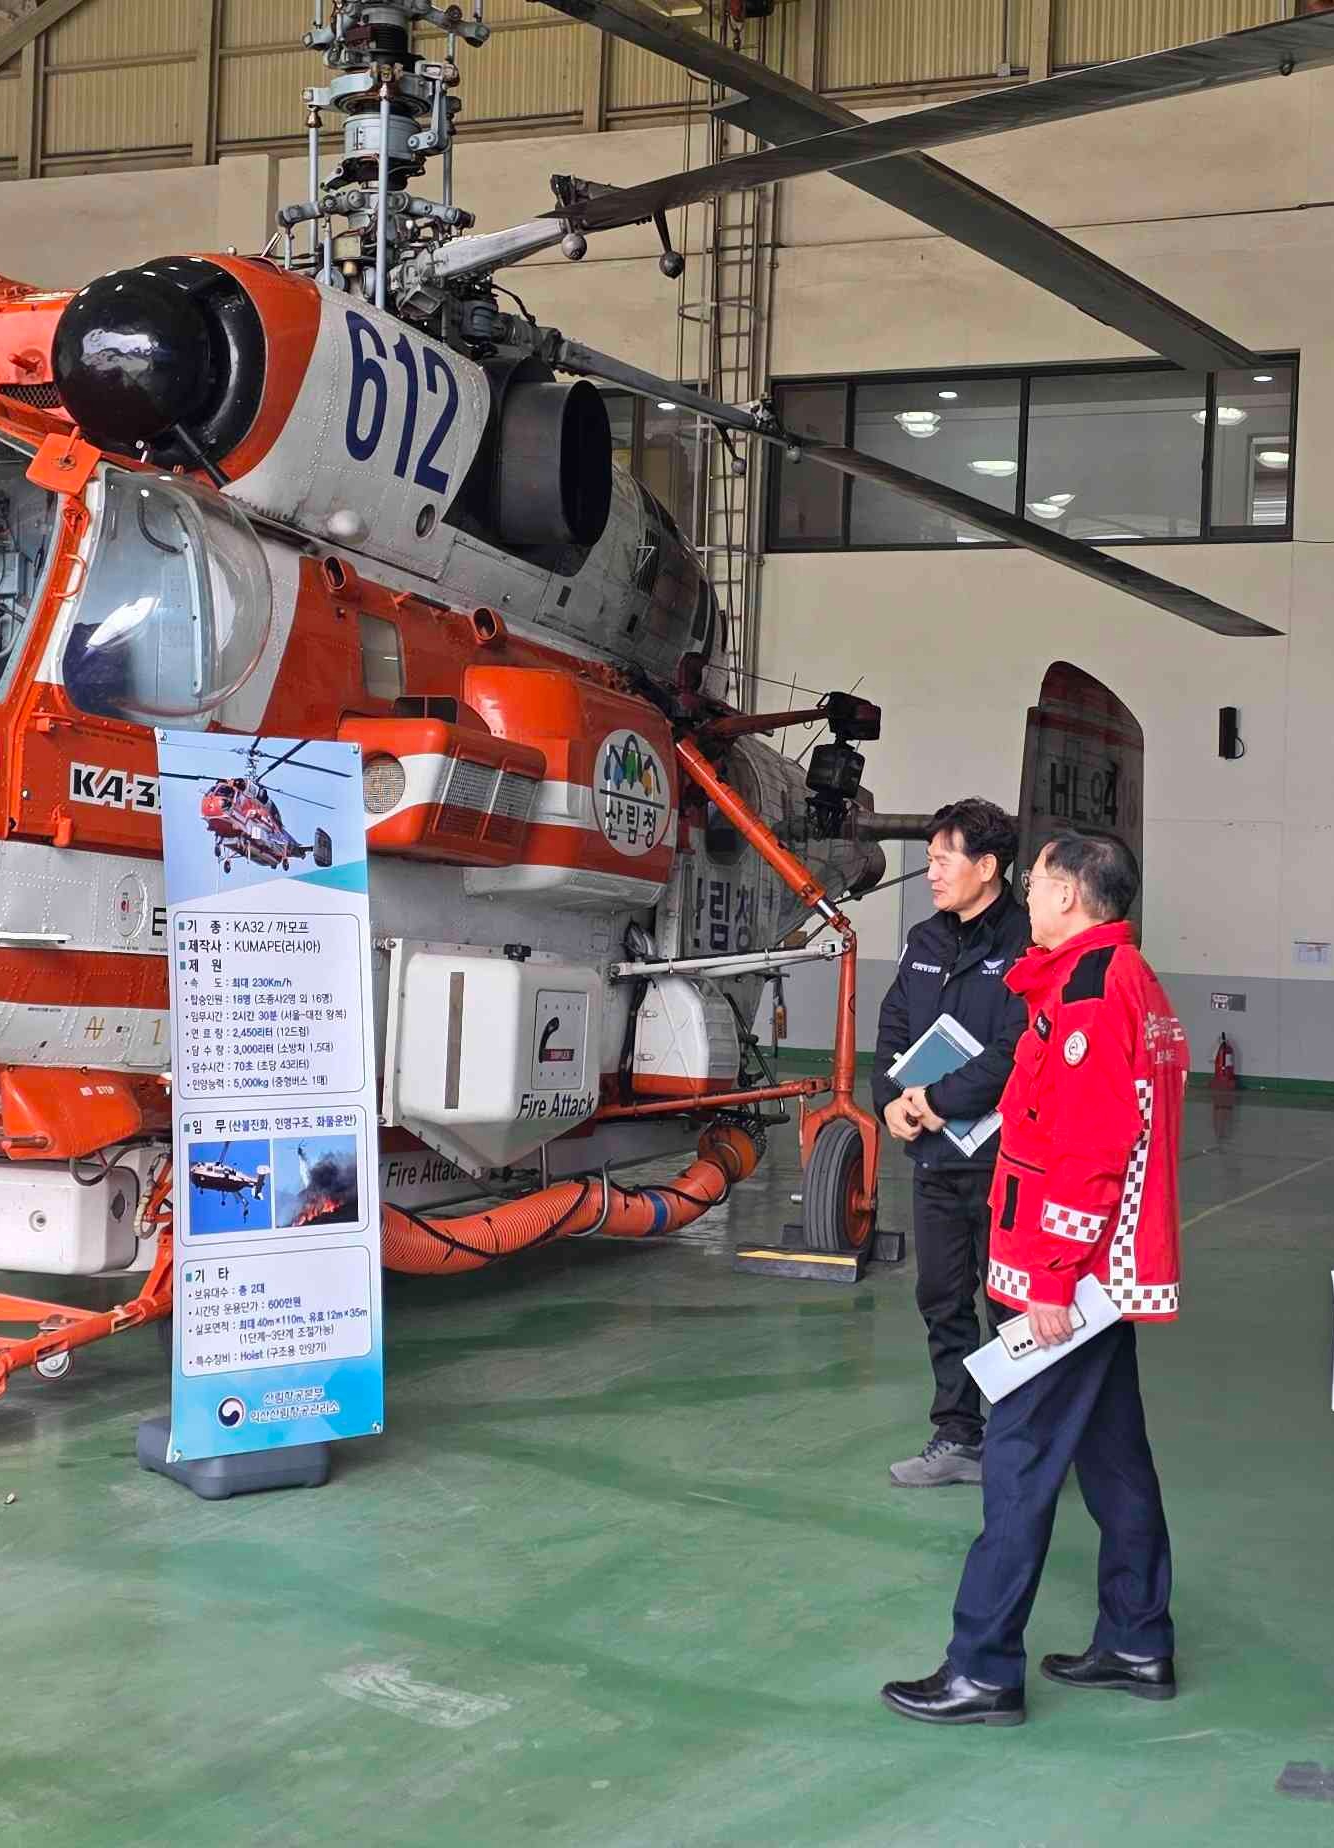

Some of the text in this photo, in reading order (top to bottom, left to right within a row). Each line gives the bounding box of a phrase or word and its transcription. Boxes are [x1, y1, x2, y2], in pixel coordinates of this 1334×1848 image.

[345, 309, 459, 494] 612
[605, 800, 657, 849] 산림청
[187, 921, 197, 933] 기
[210, 921, 222, 934] 종
[234, 921, 265, 933] KA32
[276, 922, 309, 934] 까모프
[188, 940, 321, 953] 제작사 KUMAPE(러시아)
[188, 959, 222, 973] 제 원
[191, 1011, 223, 1022] 임무시간
[232, 1011, 255, 1022] 2시간
[258, 1010, 277, 1021] 30분
[234, 1061, 255, 1072] 70초
[516, 1092, 595, 1120] Fire Attack
[192, 1120, 202, 1135] 임
[215, 1119, 227, 1134] 무
[274, 1116, 313, 1130] 인명구조,
[316, 1114, 358, 1128] 화물운반)
[386, 1158, 466, 1188] Fire Attac
[194, 1266, 230, 1283] 기 타
[250, 1282, 265, 1295] 2대
[195, 1304, 220, 1318] 시간당
[267, 1296, 302, 1309] 600만원
[240, 1349, 264, 1361] Hoist
